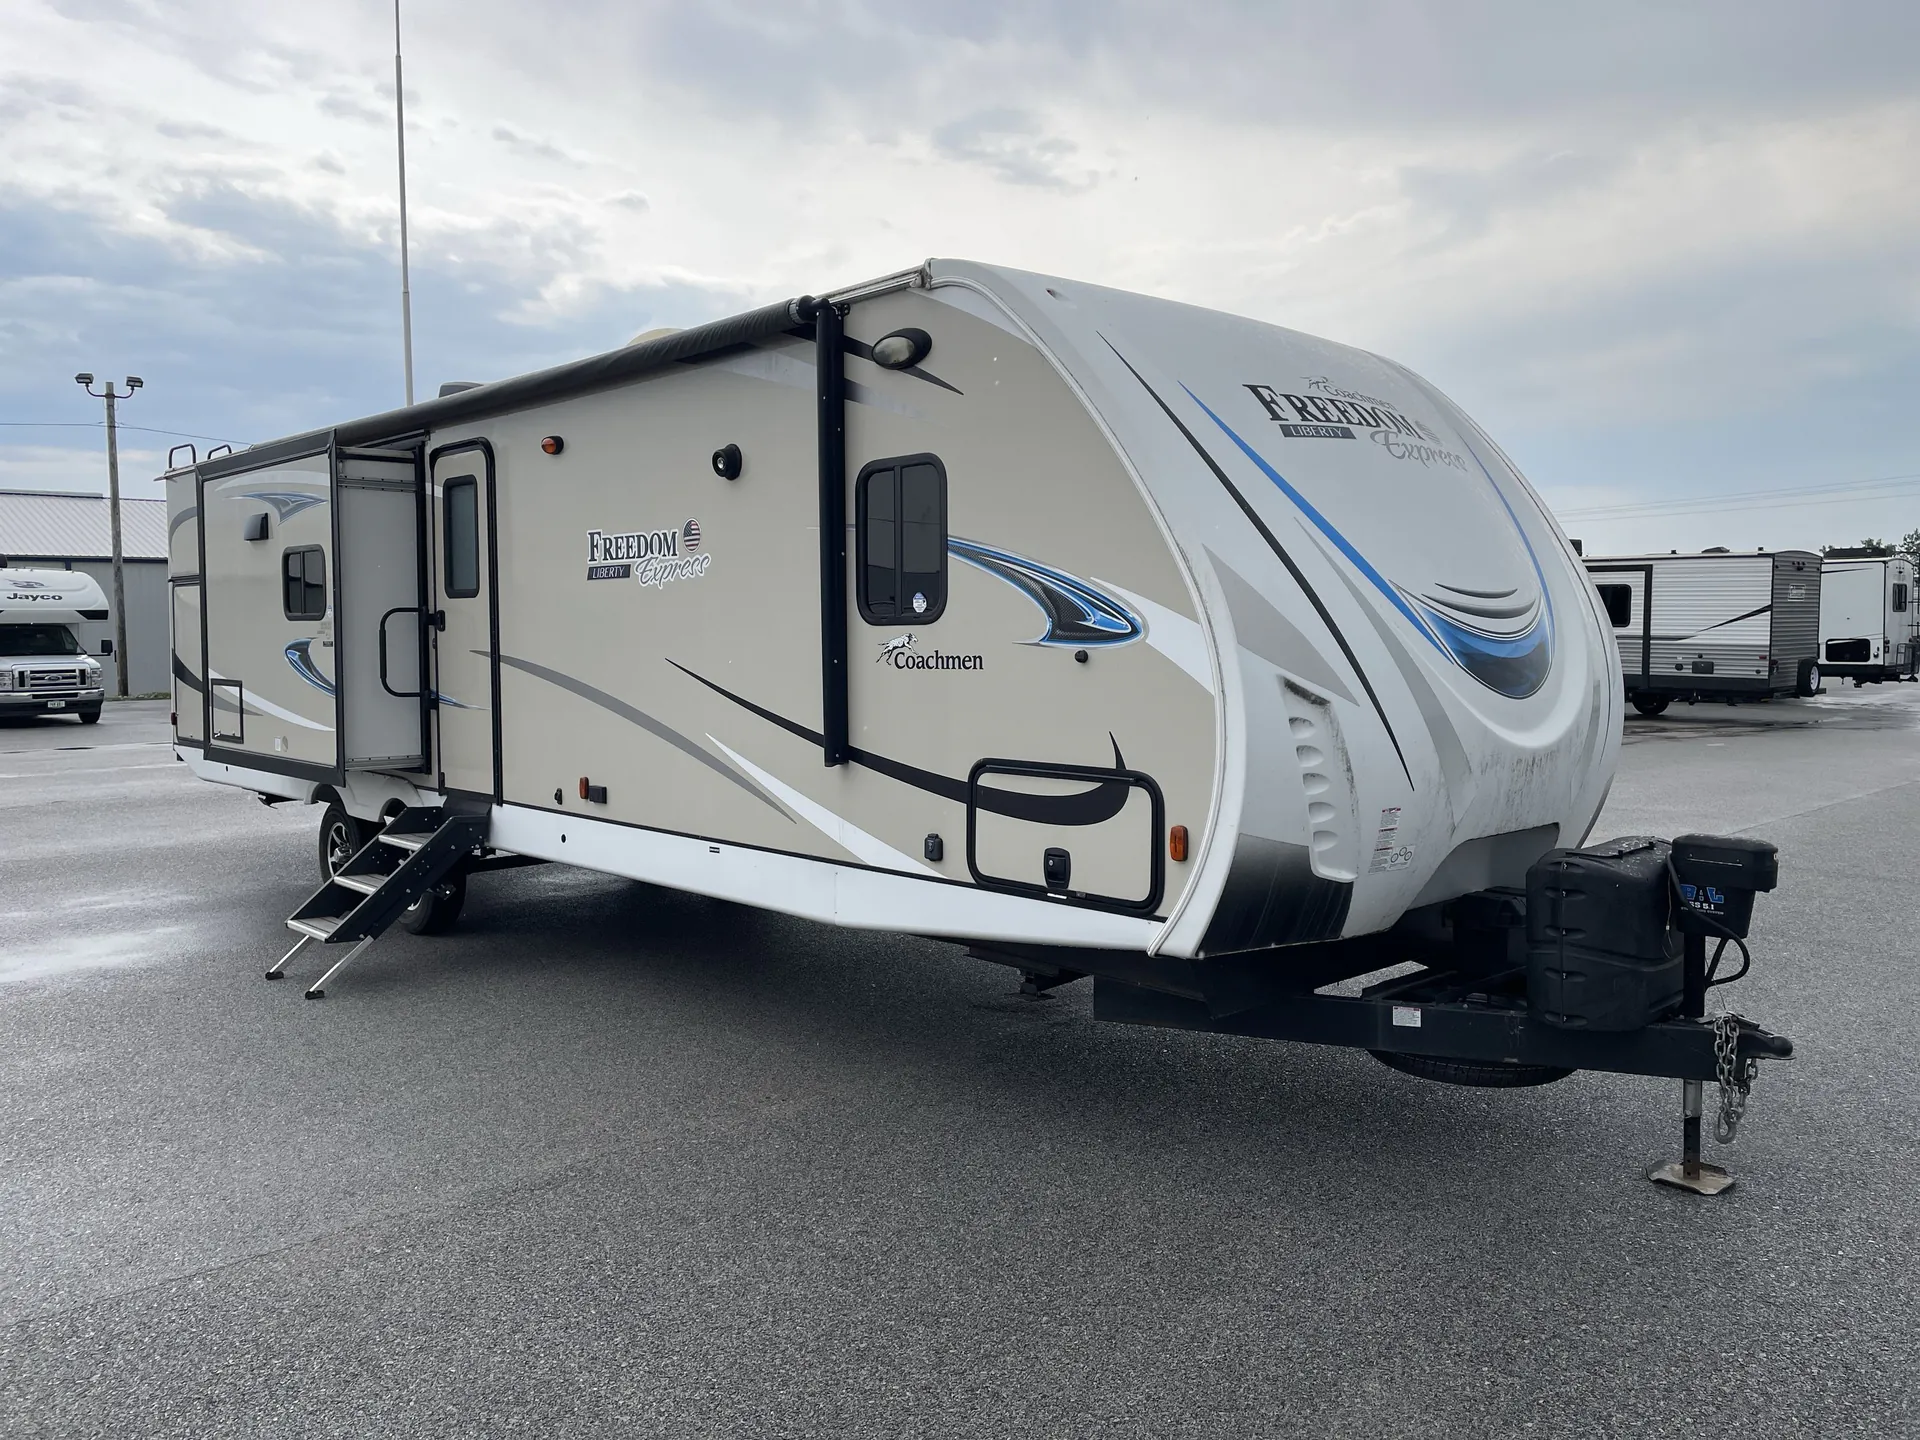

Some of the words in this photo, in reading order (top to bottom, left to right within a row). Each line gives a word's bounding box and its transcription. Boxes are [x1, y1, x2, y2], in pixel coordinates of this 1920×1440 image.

[1242, 383, 1426, 441] FREEDOM
[1323, 384, 1399, 412] Coachmen
[1291, 425, 1344, 437] LIBERTY
[1370, 429, 1468, 472] Express
[587, 530, 678, 562] FREEDOM
[592, 566, 626, 579] LIBERTY
[635, 554, 710, 588] Express
[6, 592, 63, 602] Jayco
[894, 650, 984, 670] Coachmen
